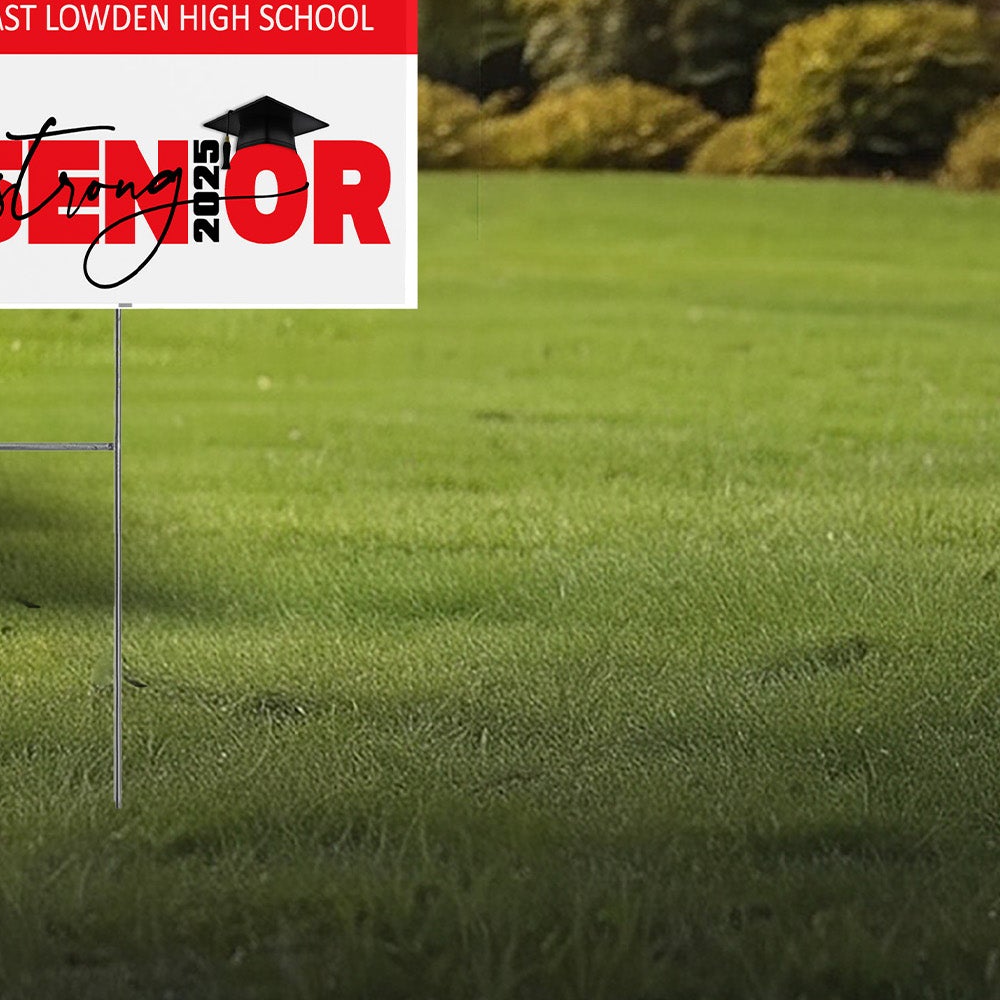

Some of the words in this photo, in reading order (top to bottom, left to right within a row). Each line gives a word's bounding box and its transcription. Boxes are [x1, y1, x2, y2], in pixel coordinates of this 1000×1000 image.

[46, 4, 169, 31] LOWDEN
[180, 4, 250, 31] HIGH
[259, 4, 375, 31] SCHOOL
[193, 139, 220, 243] 2025
